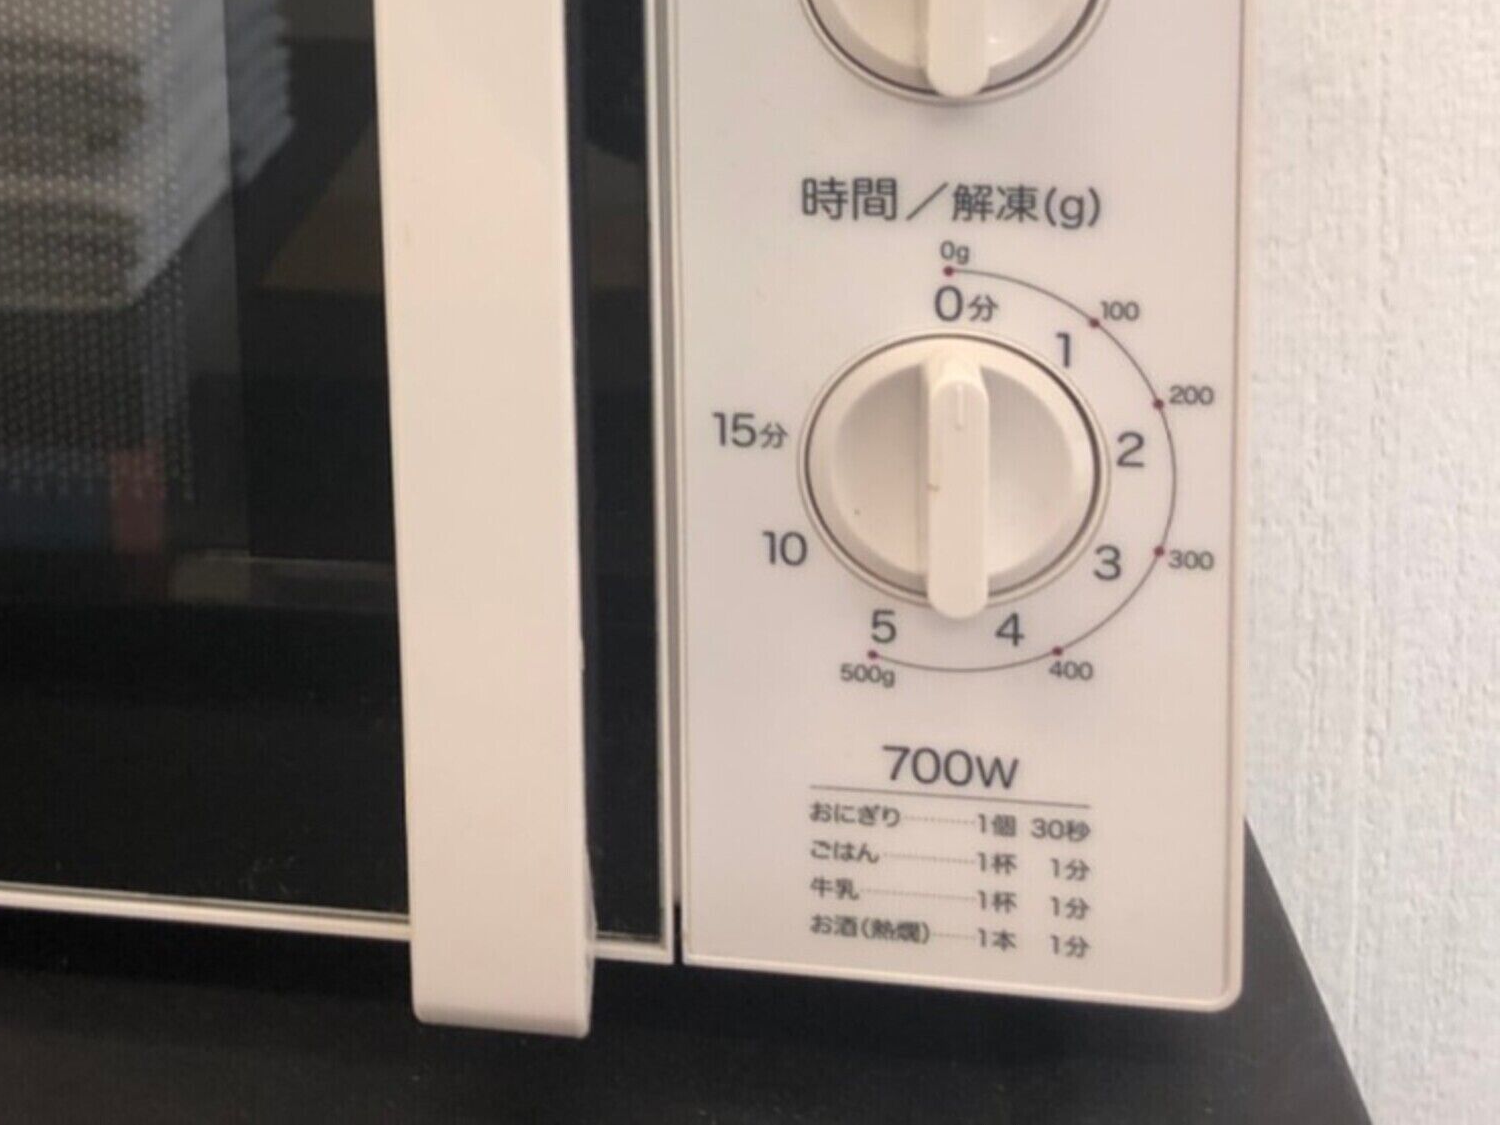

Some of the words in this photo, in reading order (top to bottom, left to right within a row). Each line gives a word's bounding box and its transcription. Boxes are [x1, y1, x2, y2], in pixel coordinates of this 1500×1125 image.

[940, 240, 970, 266] 0g
[934, 285, 998, 322] 0分
[1101, 301, 1140, 321] 100
[1056, 332, 1071, 368] 1
[1169, 385, 1215, 406] 200
[713, 412, 788, 449] 15分
[1116, 431, 1144, 468] 2
[763, 531, 808, 567] 10
[1094, 544, 1121, 581] 3
[1168, 549, 1215, 571] 300
[871, 609, 897, 644] 5
[995, 613, 1024, 647] 4
[840, 660, 898, 689] 500g
[1046, 656, 1094, 681] 400
[882, 745, 1019, 790] 700W
[810, 802, 900, 827] おにぎり
[978, 814, 1017, 838] 1個
[1031, 818, 1091, 842] 30秒
[810, 840, 879, 864] ごはん
[978, 852, 1017, 874] 1杯
[1051, 858, 1090, 881] 1分
[810, 877, 859, 901] 牛乳
[978, 890, 1016, 913] 1杯
[1051, 896, 1090, 920] 1分
[978, 928, 1016, 951] 1本
[1050, 935, 1090, 959] 1分
